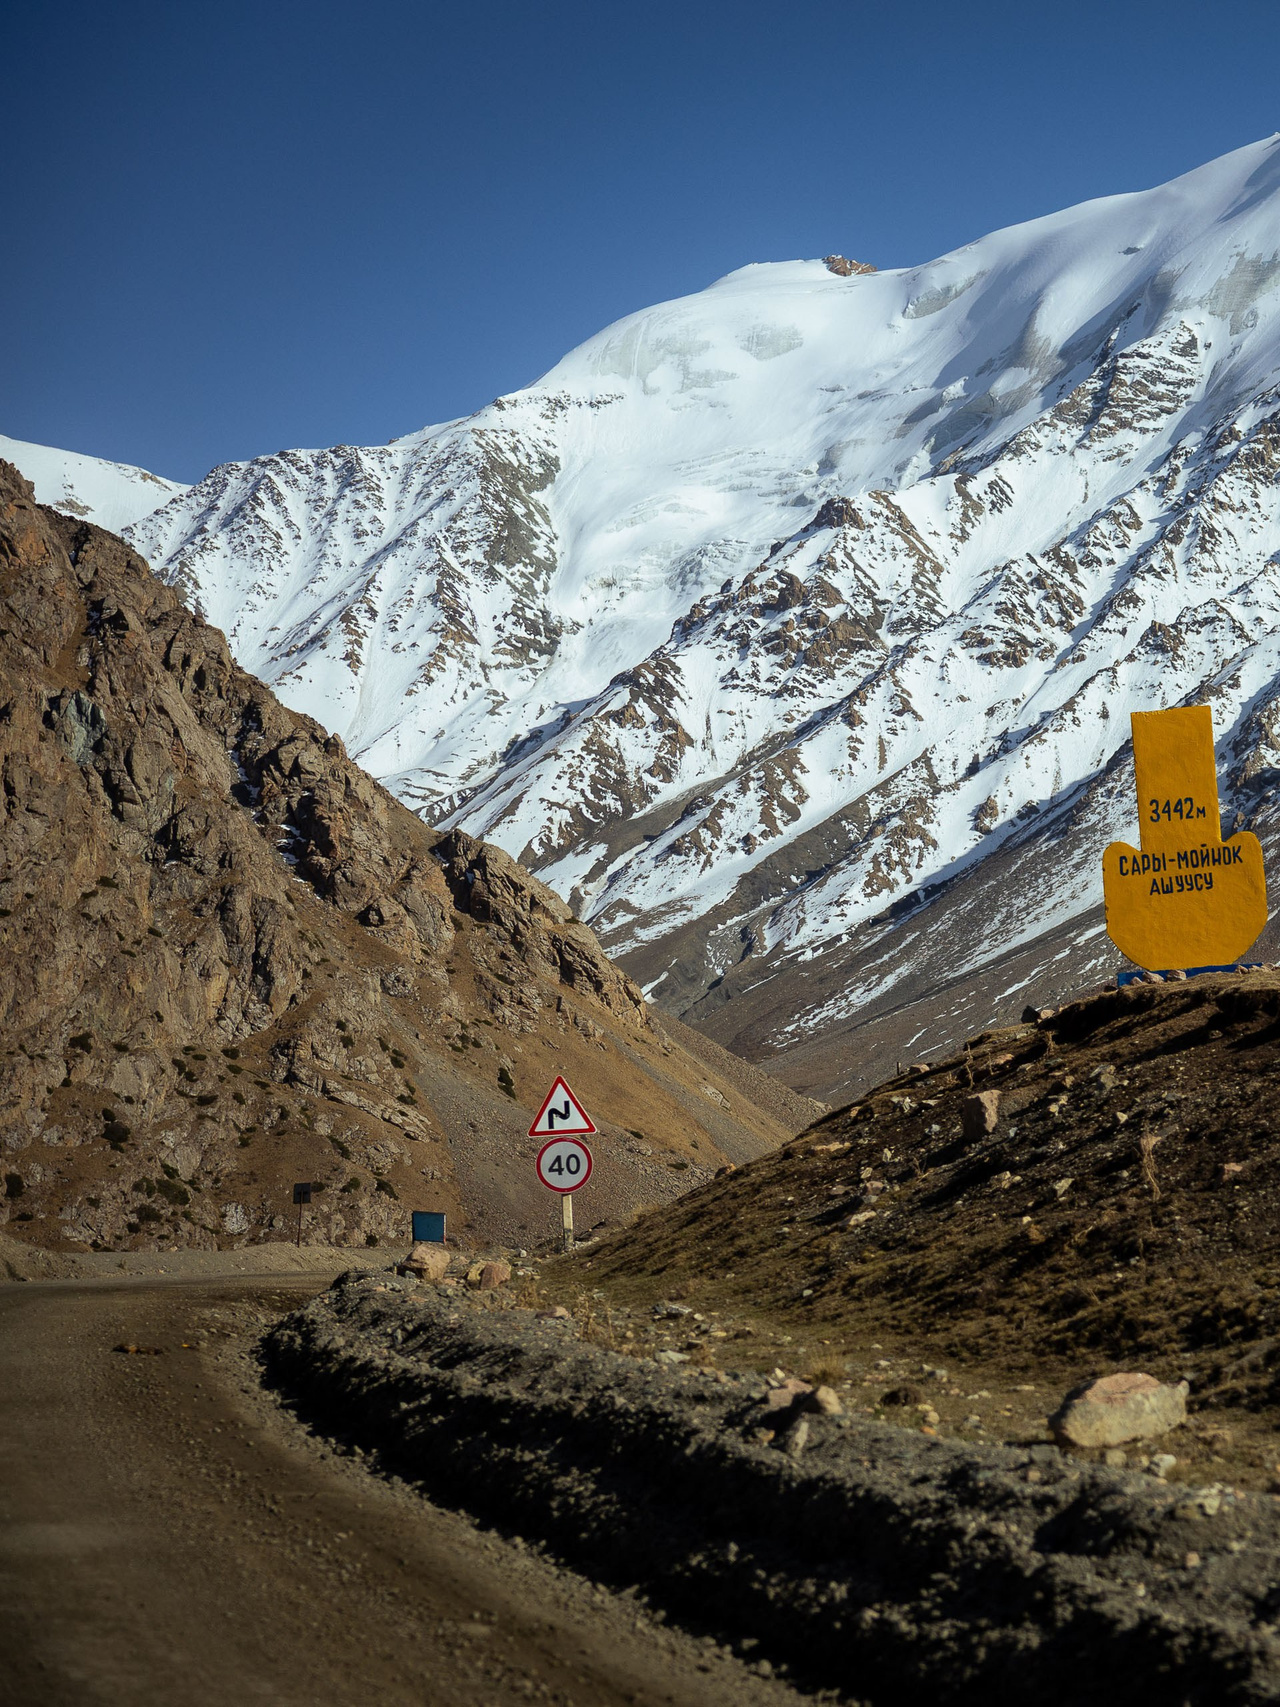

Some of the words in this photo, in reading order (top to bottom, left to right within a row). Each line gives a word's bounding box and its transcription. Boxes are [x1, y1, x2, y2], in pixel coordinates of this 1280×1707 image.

[1119, 844, 1243, 876] САРЫ-МОЙНОК
[1149, 872, 1214, 896] АШУУСУ
[548, 1154, 580, 1175] 40
